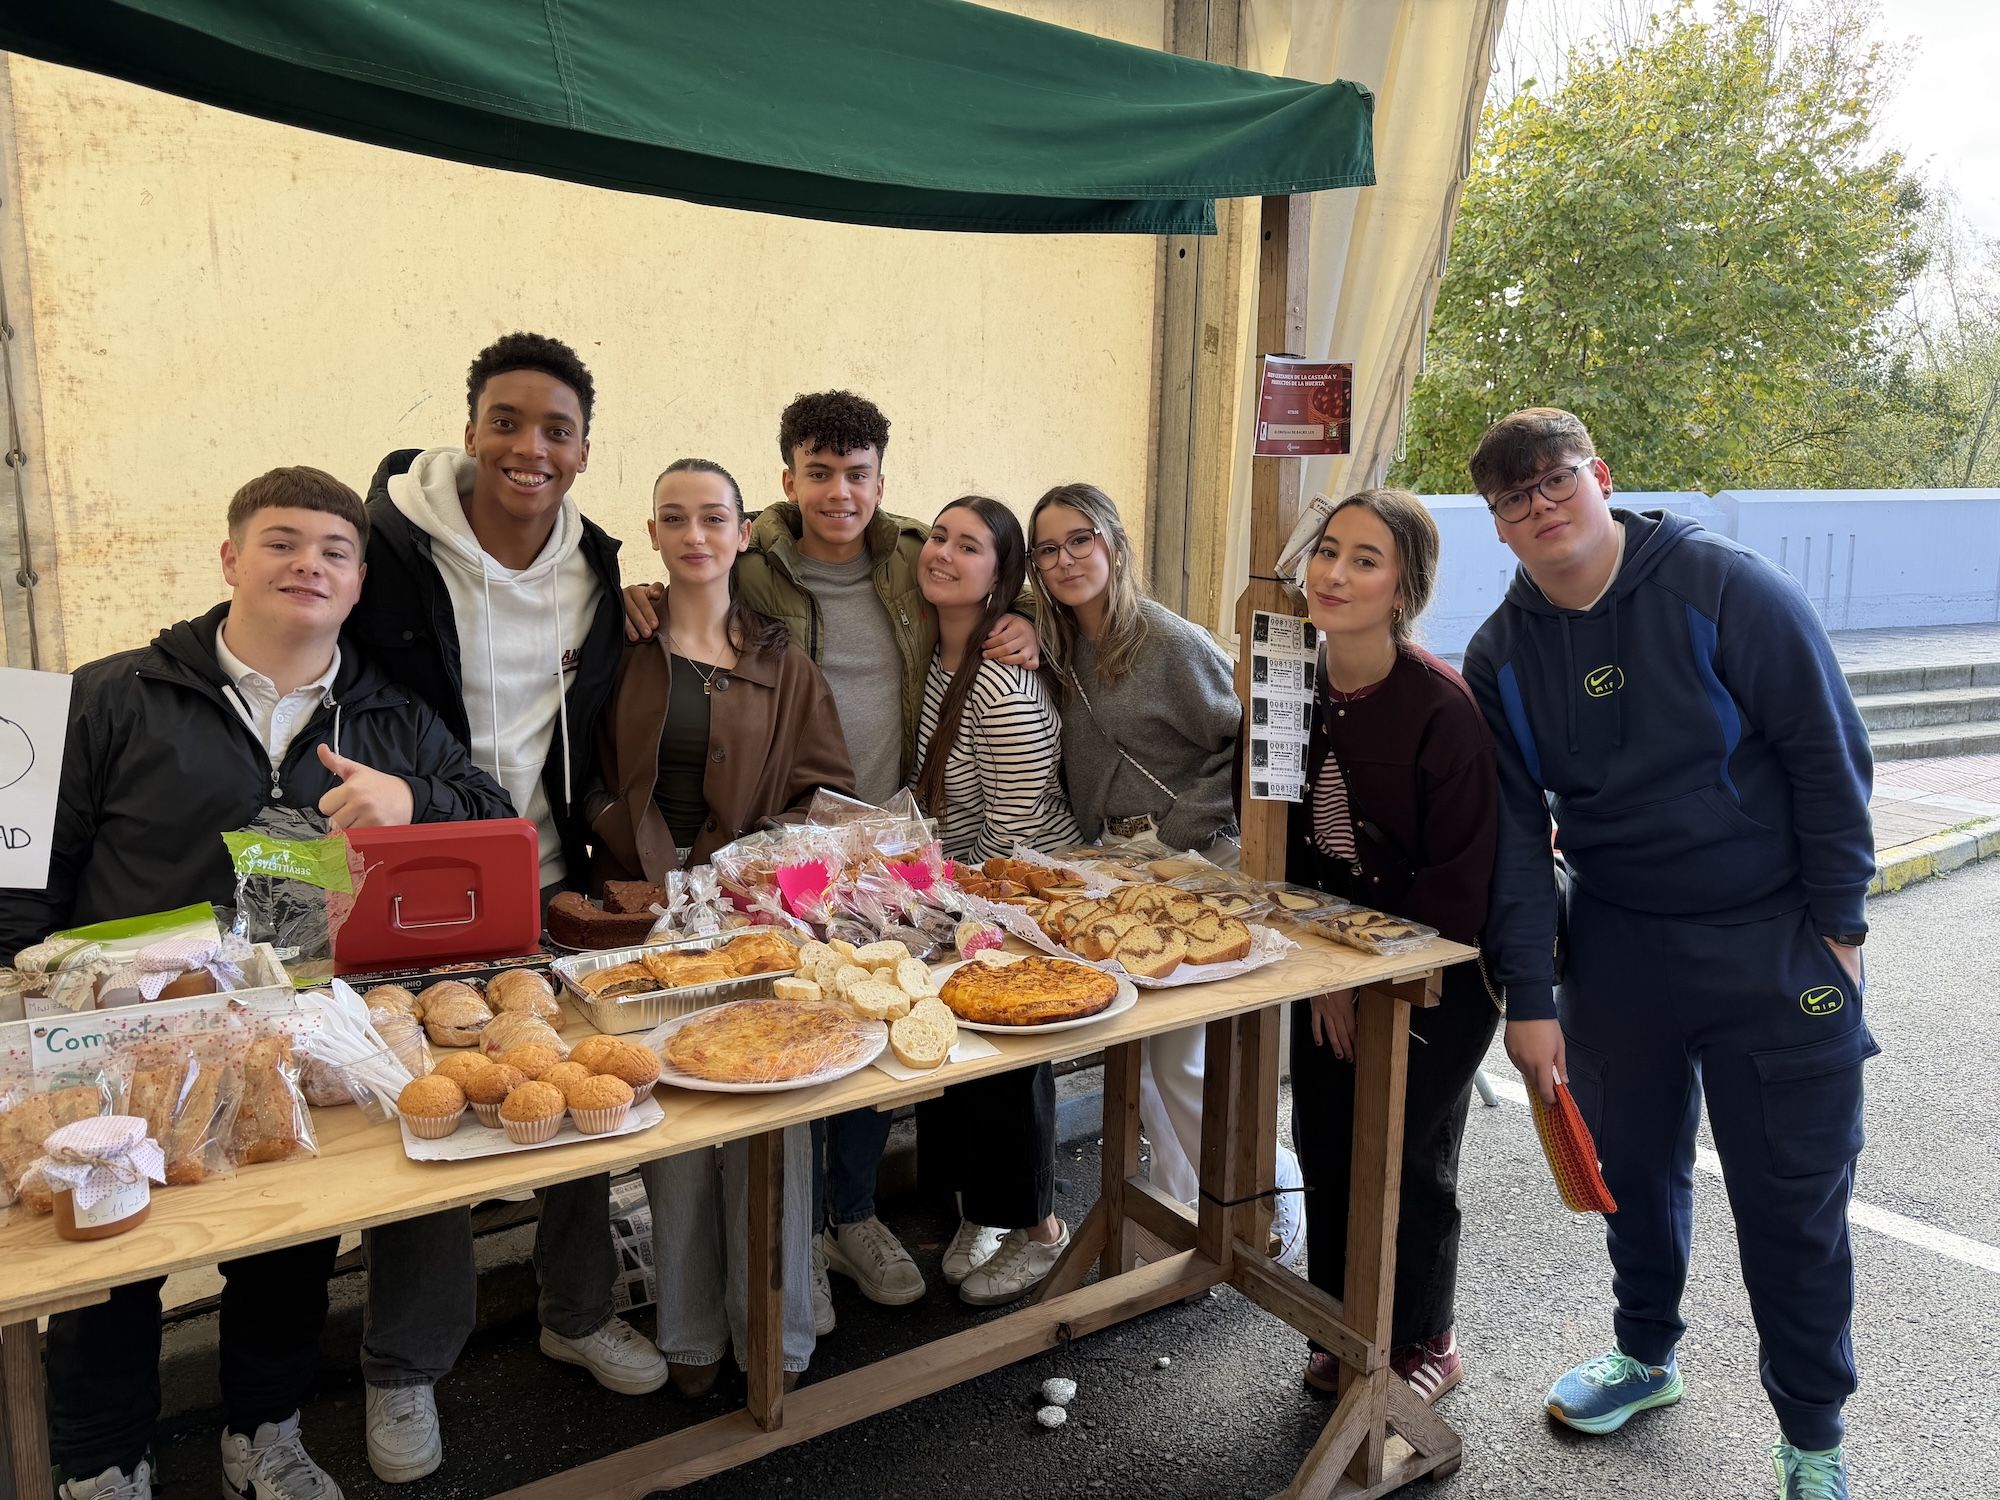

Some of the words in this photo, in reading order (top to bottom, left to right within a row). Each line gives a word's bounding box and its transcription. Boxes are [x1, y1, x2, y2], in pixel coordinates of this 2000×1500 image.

[1270, 660, 1293, 669] 00813
[1270, 701, 1293, 710] 00813
[1270, 742, 1293, 751] 00813
[1270, 784, 1293, 793] 00813
[257, 859, 311, 876] SERVILLETAS
[46, 1015, 169, 1053] Compota
